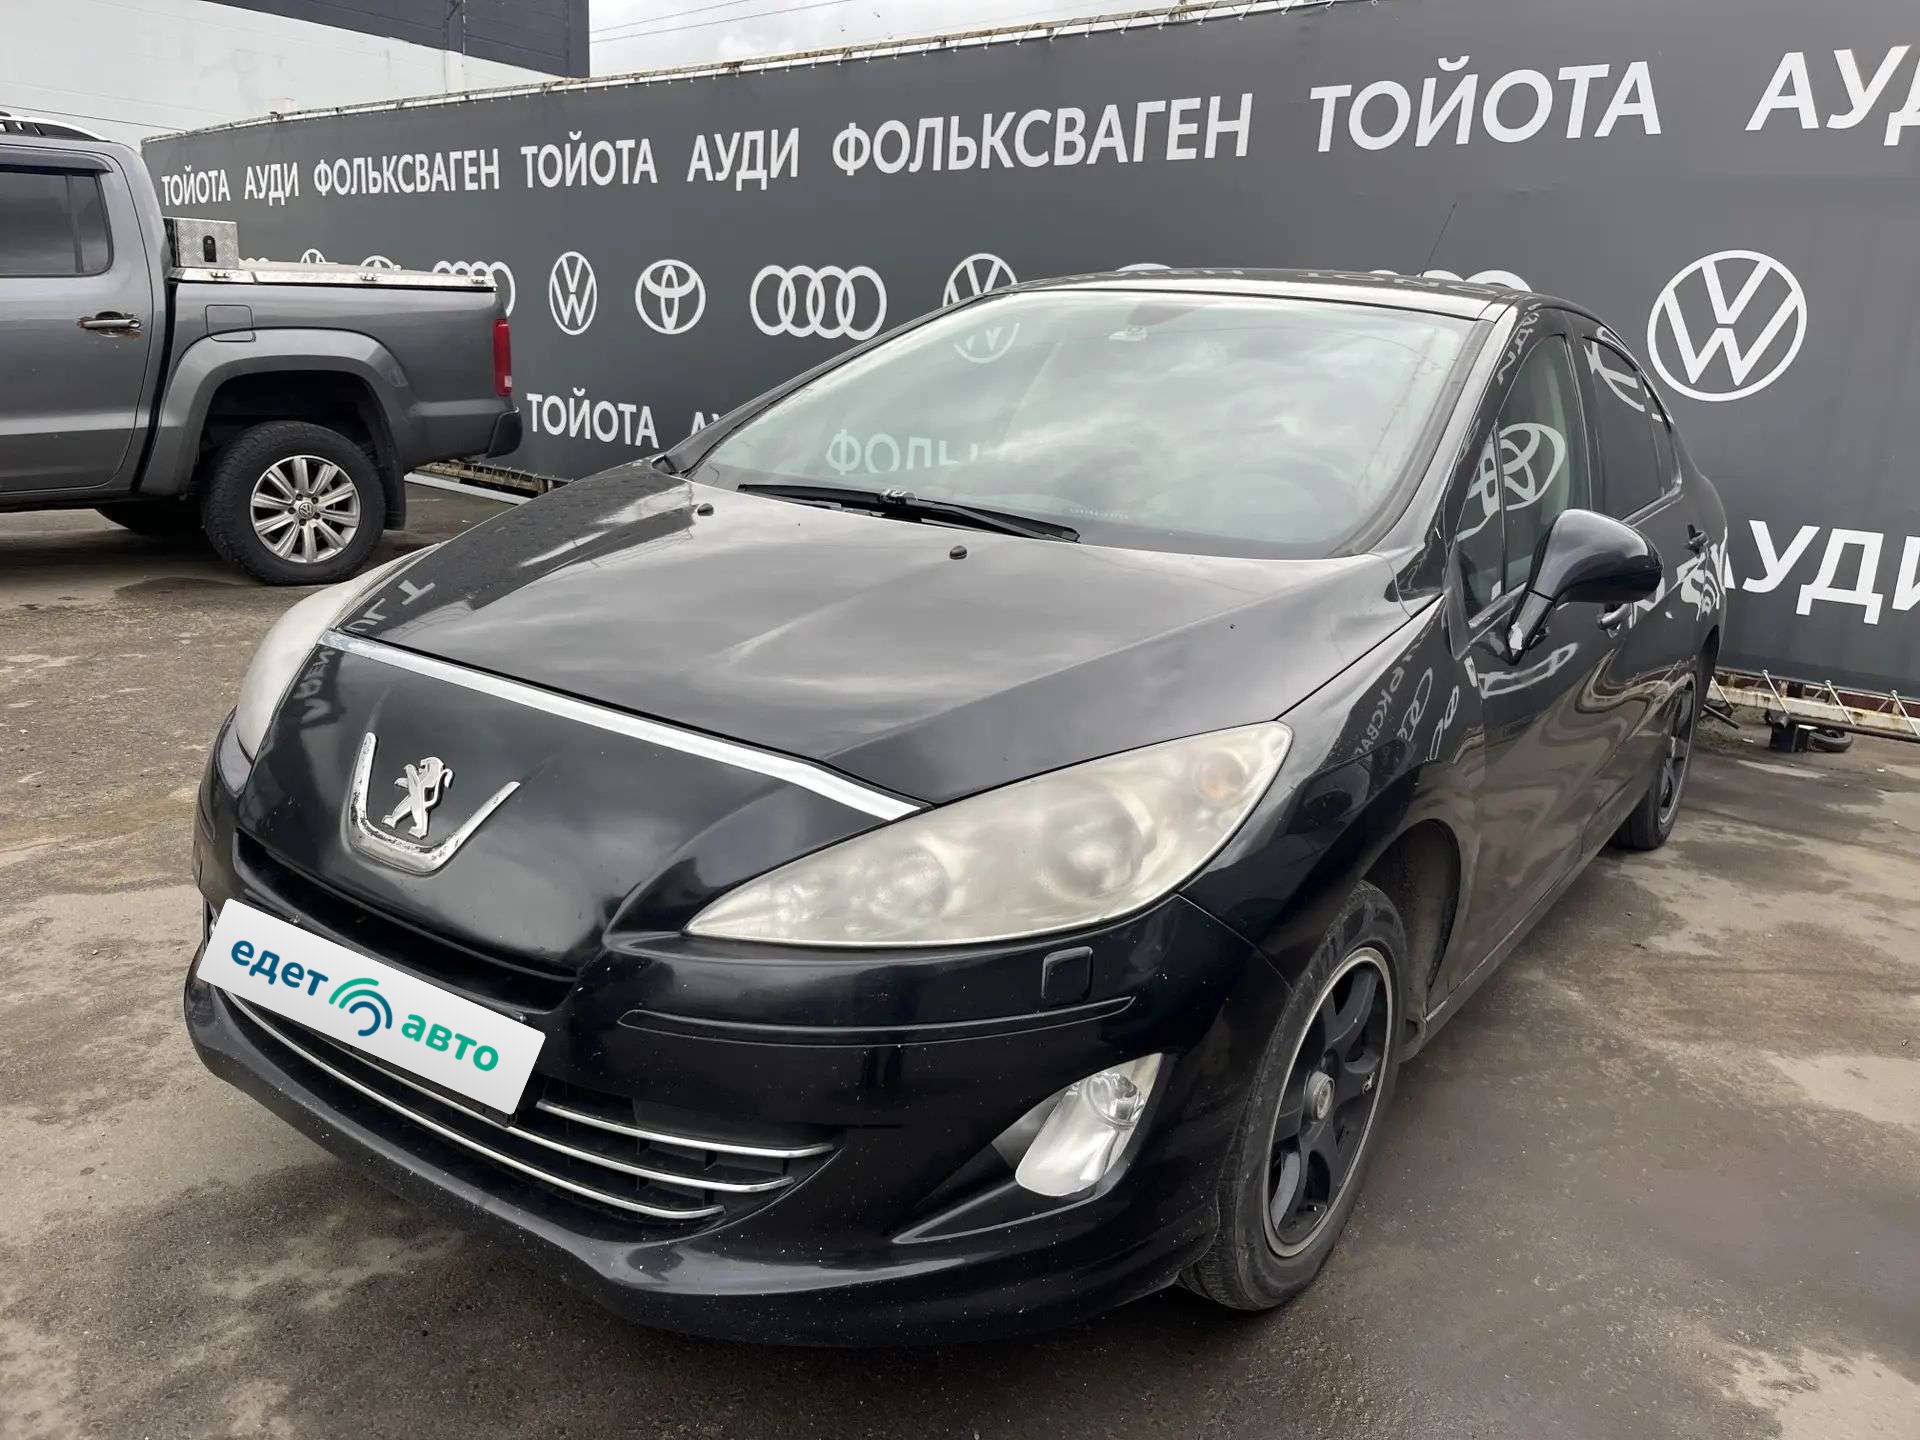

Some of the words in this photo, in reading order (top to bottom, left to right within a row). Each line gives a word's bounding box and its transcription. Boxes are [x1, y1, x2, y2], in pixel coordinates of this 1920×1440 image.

[161, 164, 231, 206] ТОЙОТА
[245, 162, 299, 206] АУДИ
[314, 149, 499, 196] ФОЛЬКСВАГЕН
[521, 131, 657, 187] ТОЙОТА
[687, 128, 798, 191] АУДИ
[833, 93, 1252, 175] ФОЛЬКСВАГЕН
[1311, 56, 1661, 152] ТОЙОТА
[527, 388, 659, 448] ТОЙОТА
[1724, 519, 1920, 625] УД
